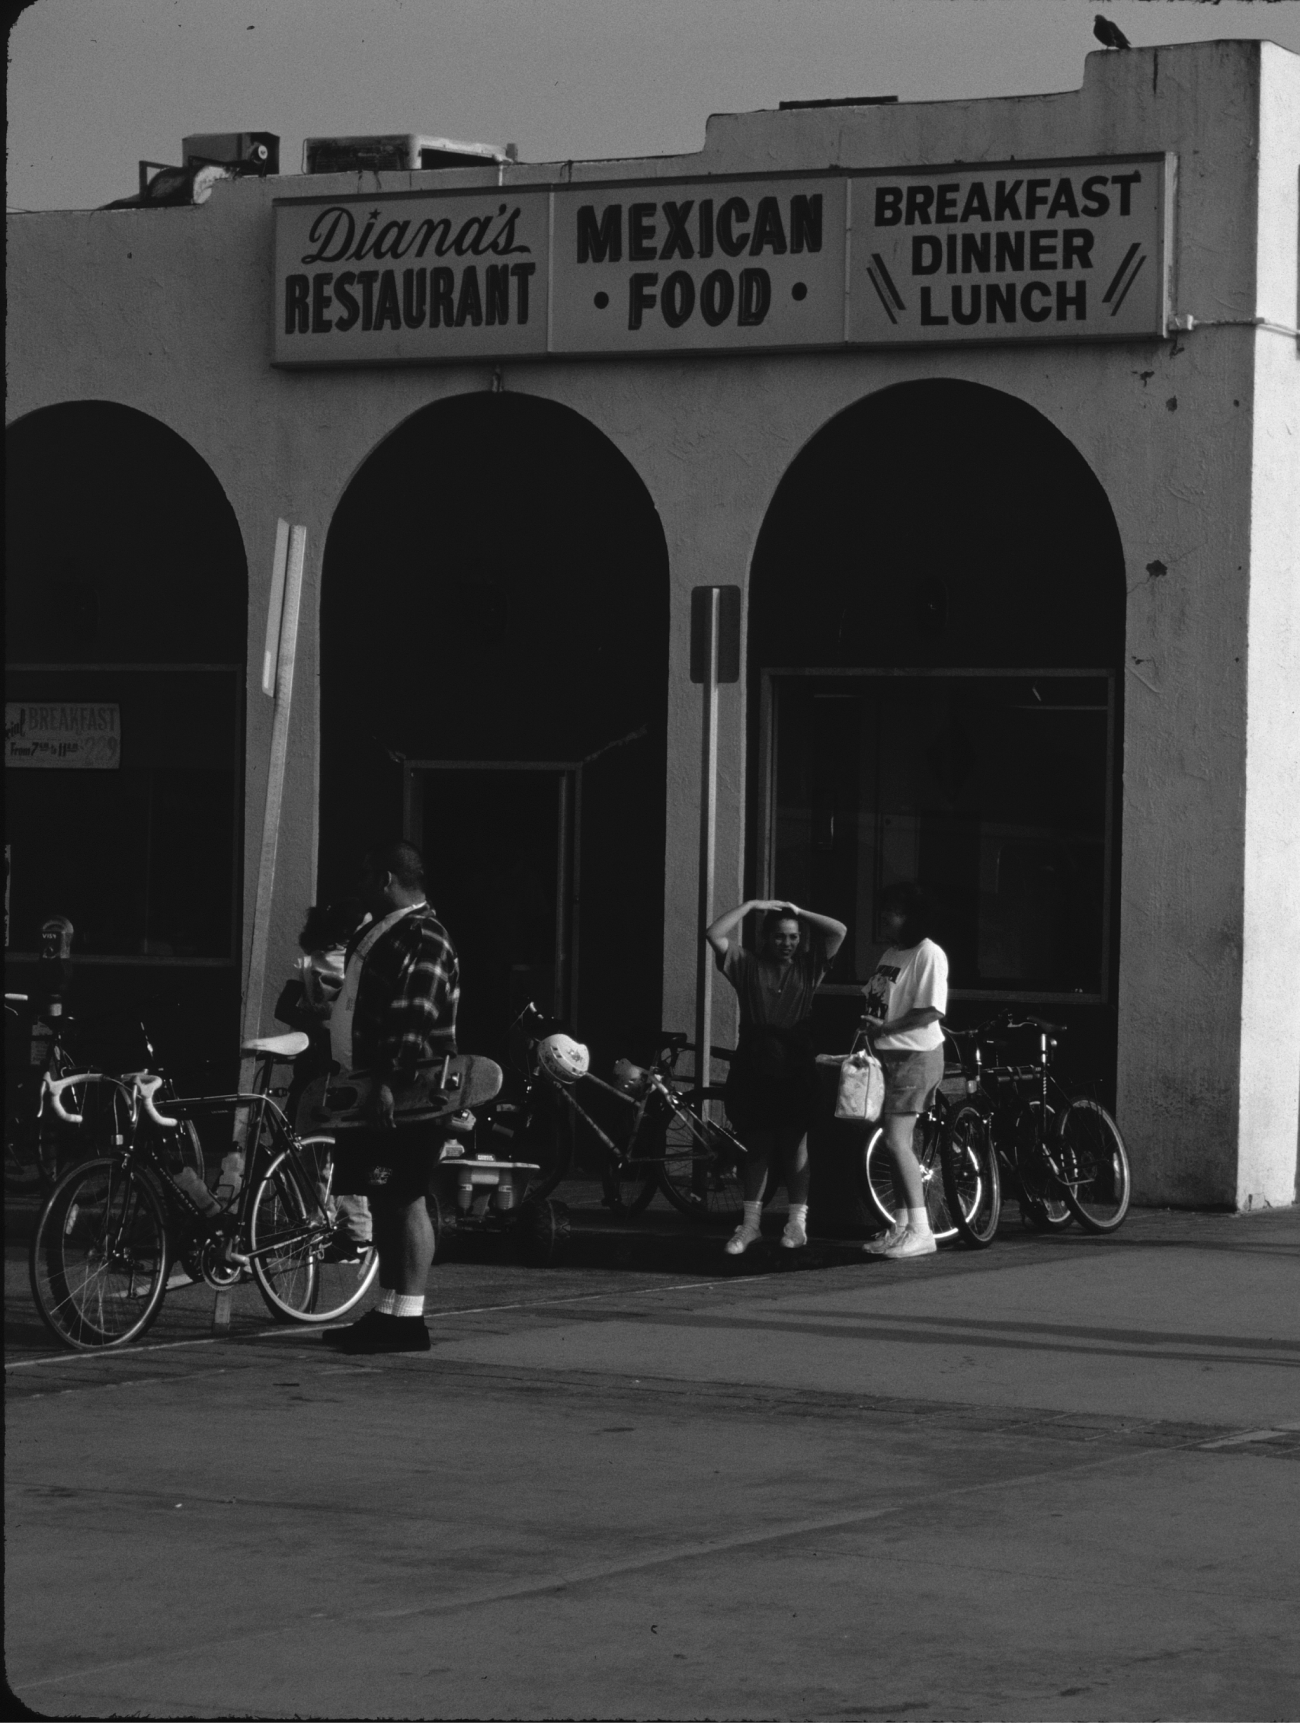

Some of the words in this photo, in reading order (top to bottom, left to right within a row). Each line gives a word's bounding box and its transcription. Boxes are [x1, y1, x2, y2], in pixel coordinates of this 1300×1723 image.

[874, 171, 1142, 227] BREAKFAST
[302, 204, 532, 265] Diana's
[576, 193, 823, 264] MEXICAN
[911, 228, 1095, 276] DINNER
[284, 262, 536, 334] RESTAURANT
[627, 267, 772, 331] FOOD
[920, 280, 1087, 326] LUNCH
[28, 707, 116, 731] BREAKFAST
